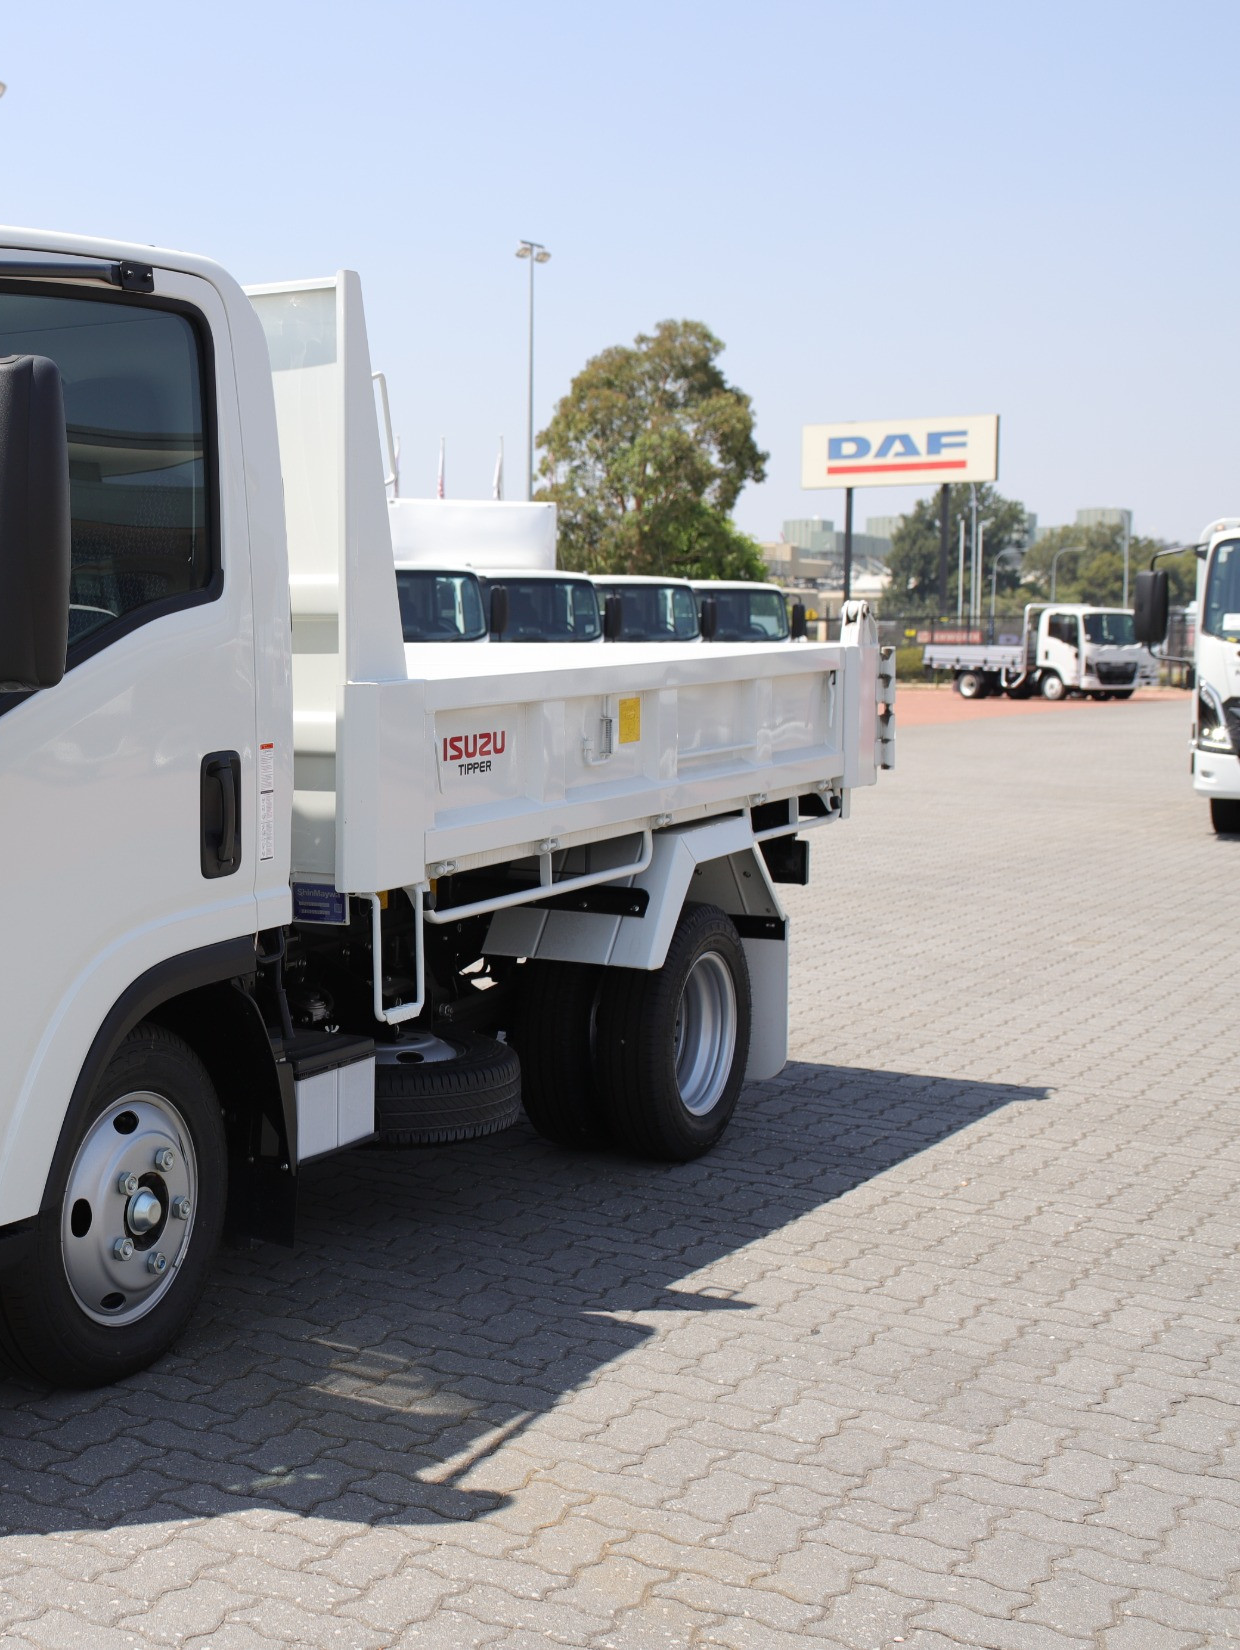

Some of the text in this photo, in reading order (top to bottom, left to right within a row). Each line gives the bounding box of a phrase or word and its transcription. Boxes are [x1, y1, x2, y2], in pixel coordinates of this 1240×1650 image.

[828, 430, 968, 460] DAF
[443, 731, 505, 762] ISUZU
[458, 761, 492, 776] TIPPER
